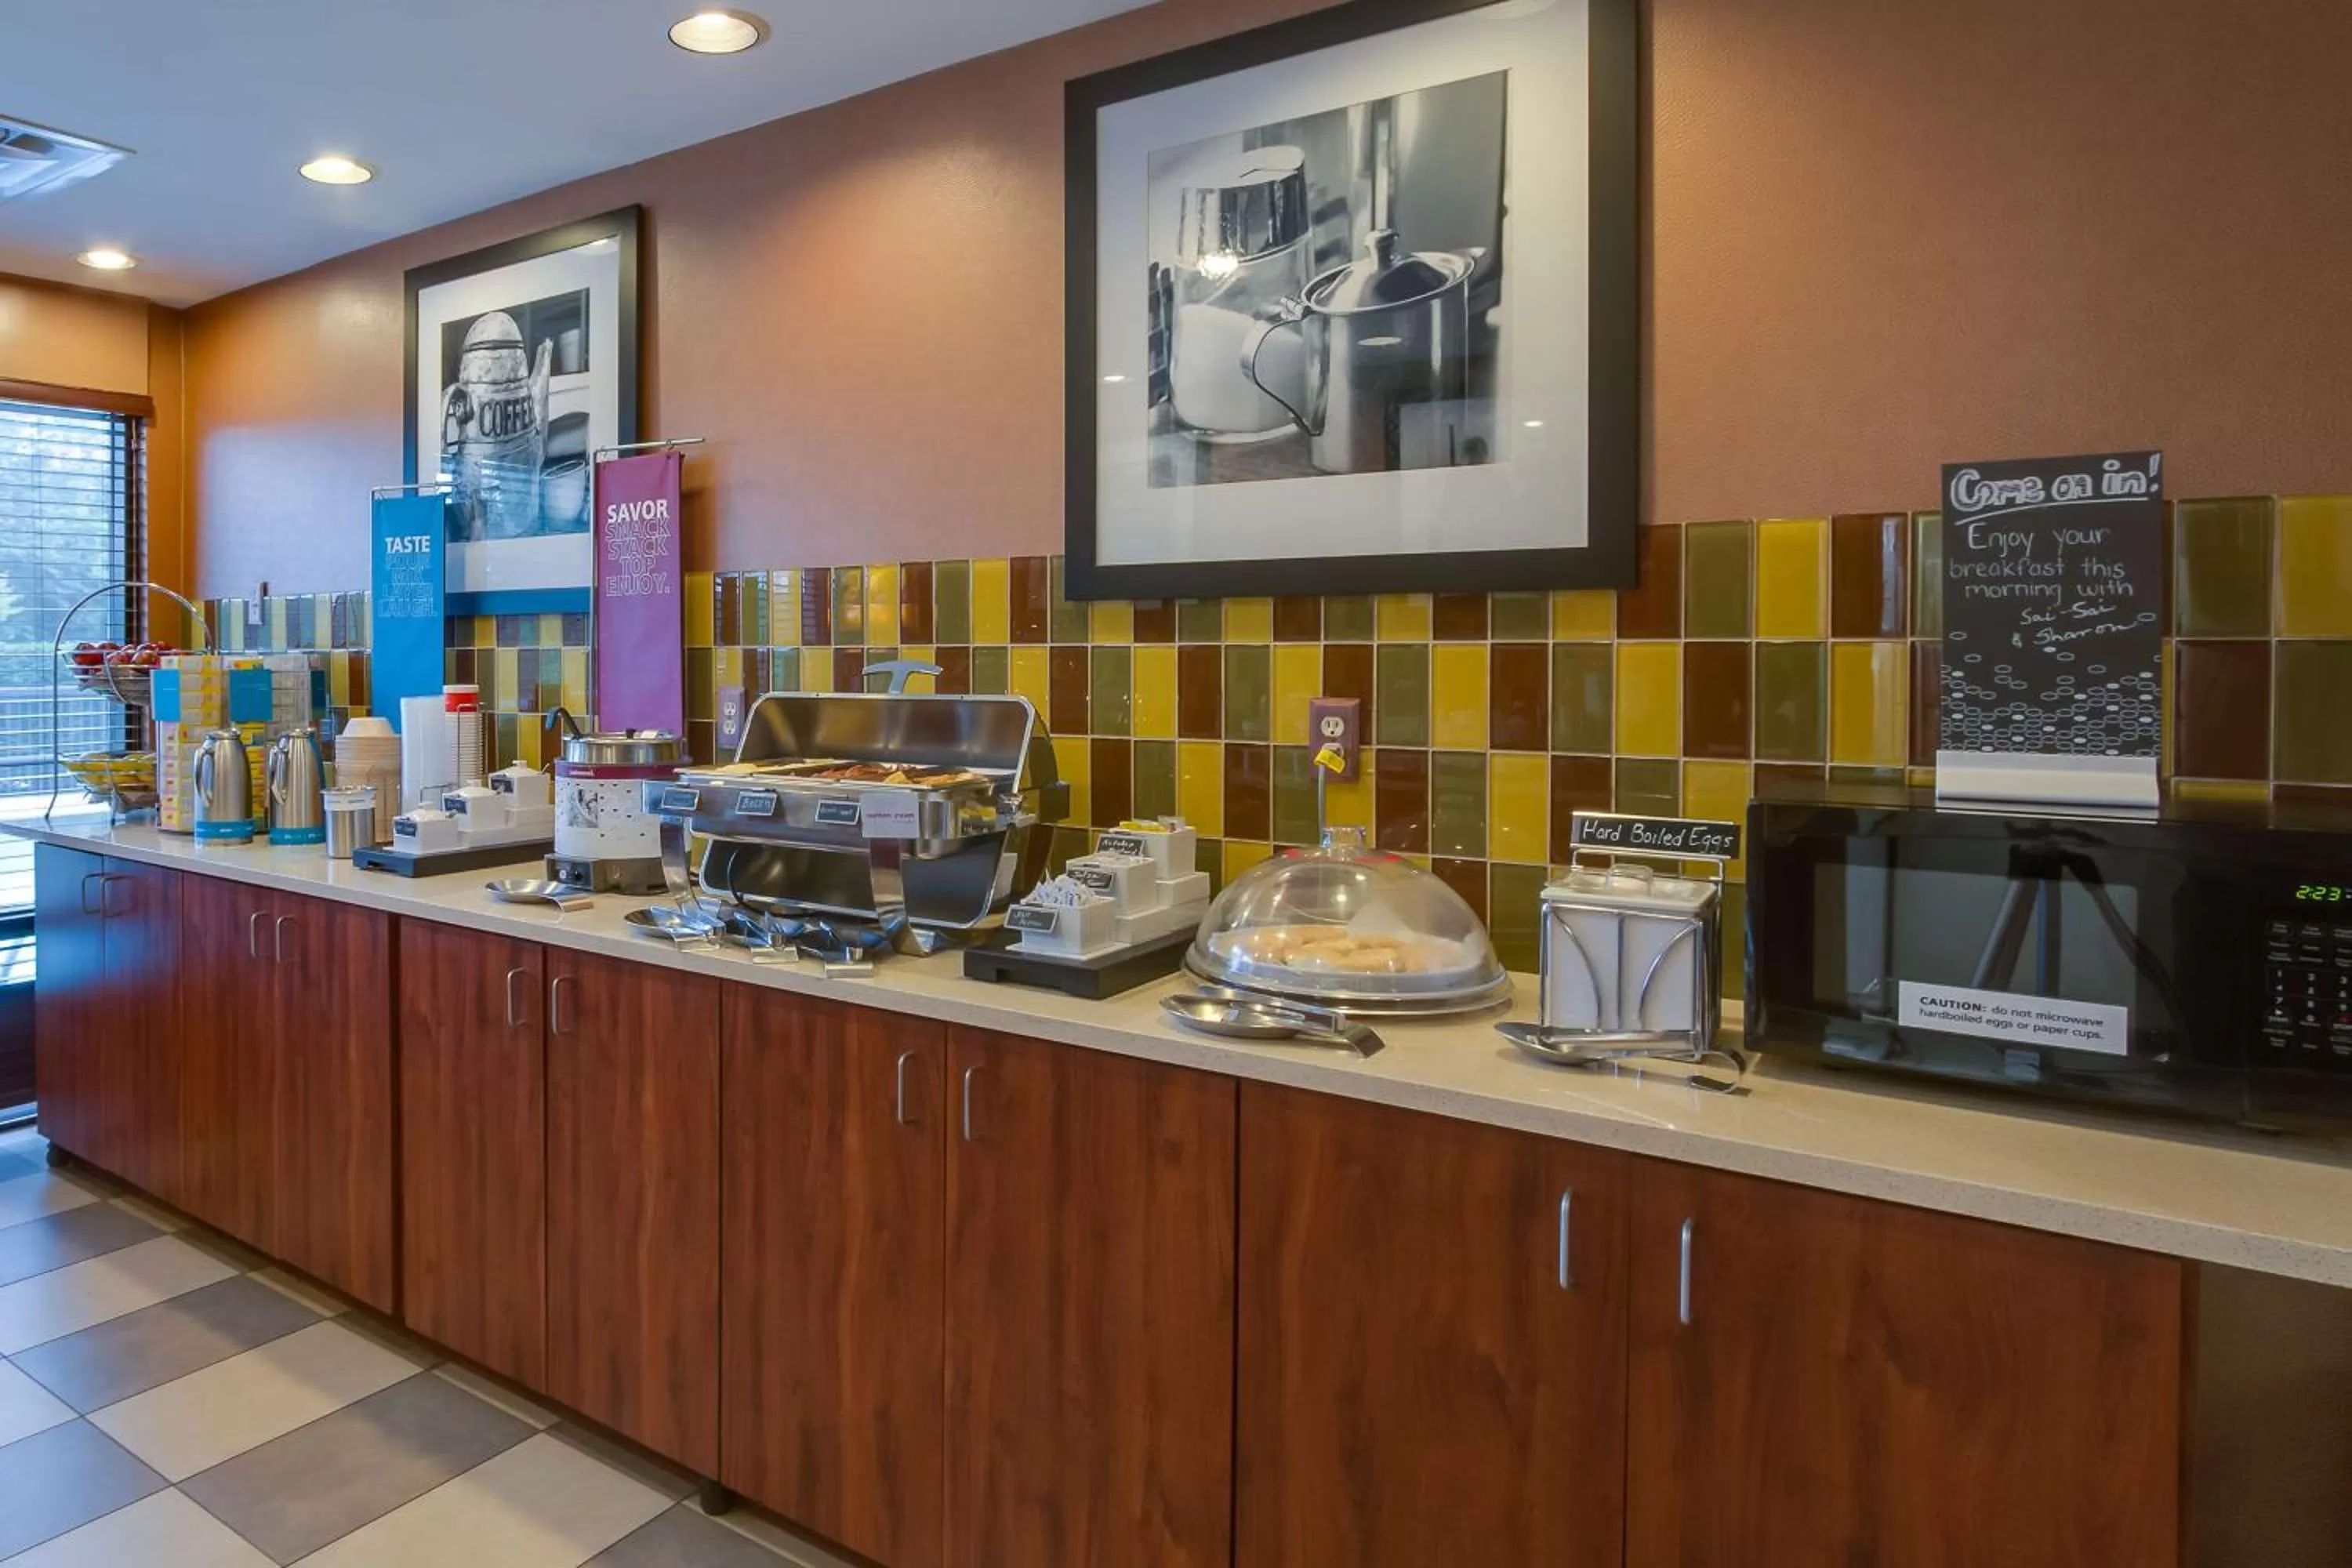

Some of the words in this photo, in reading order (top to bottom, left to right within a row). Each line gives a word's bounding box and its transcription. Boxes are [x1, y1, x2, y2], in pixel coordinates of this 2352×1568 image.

[1950, 469, 2045, 511] Come
[2052, 473, 2092, 499] on
[2102, 452, 2161, 495] in!
[607, 499, 670, 524] SAVOR
[605, 517, 671, 541] SNACK
[1968, 522, 2035, 557] Enjoy
[2053, 527, 2111, 557] your
[384, 535, 431, 554] TASTE
[608, 535, 669, 561] STACK
[618, 555, 656, 576] TOP
[1950, 557, 2065, 578] breakfast
[2080, 557, 2125, 578] this
[1965, 582, 2063, 607] morning
[2077, 580, 2133, 598] with
[1582, 819, 1622, 841] Hard
[1630, 823, 1686, 846] Boiled
[1689, 826, 1734, 854] Eggs
[1919, 996, 1987, 1012] CAUTION:
[1991, 1004, 2008, 1015] do
[2010, 1008, 2032, 1018] not
[2035, 1011, 2104, 1026] microwave
[1919, 1008, 1983, 1024] hardboiled
[1985, 1018, 2013, 1029] eggs
[2016, 1021, 2031, 1030] or
[2033, 1024, 2068, 1036] paper
[2072, 1029, 2104, 1040] cups.
